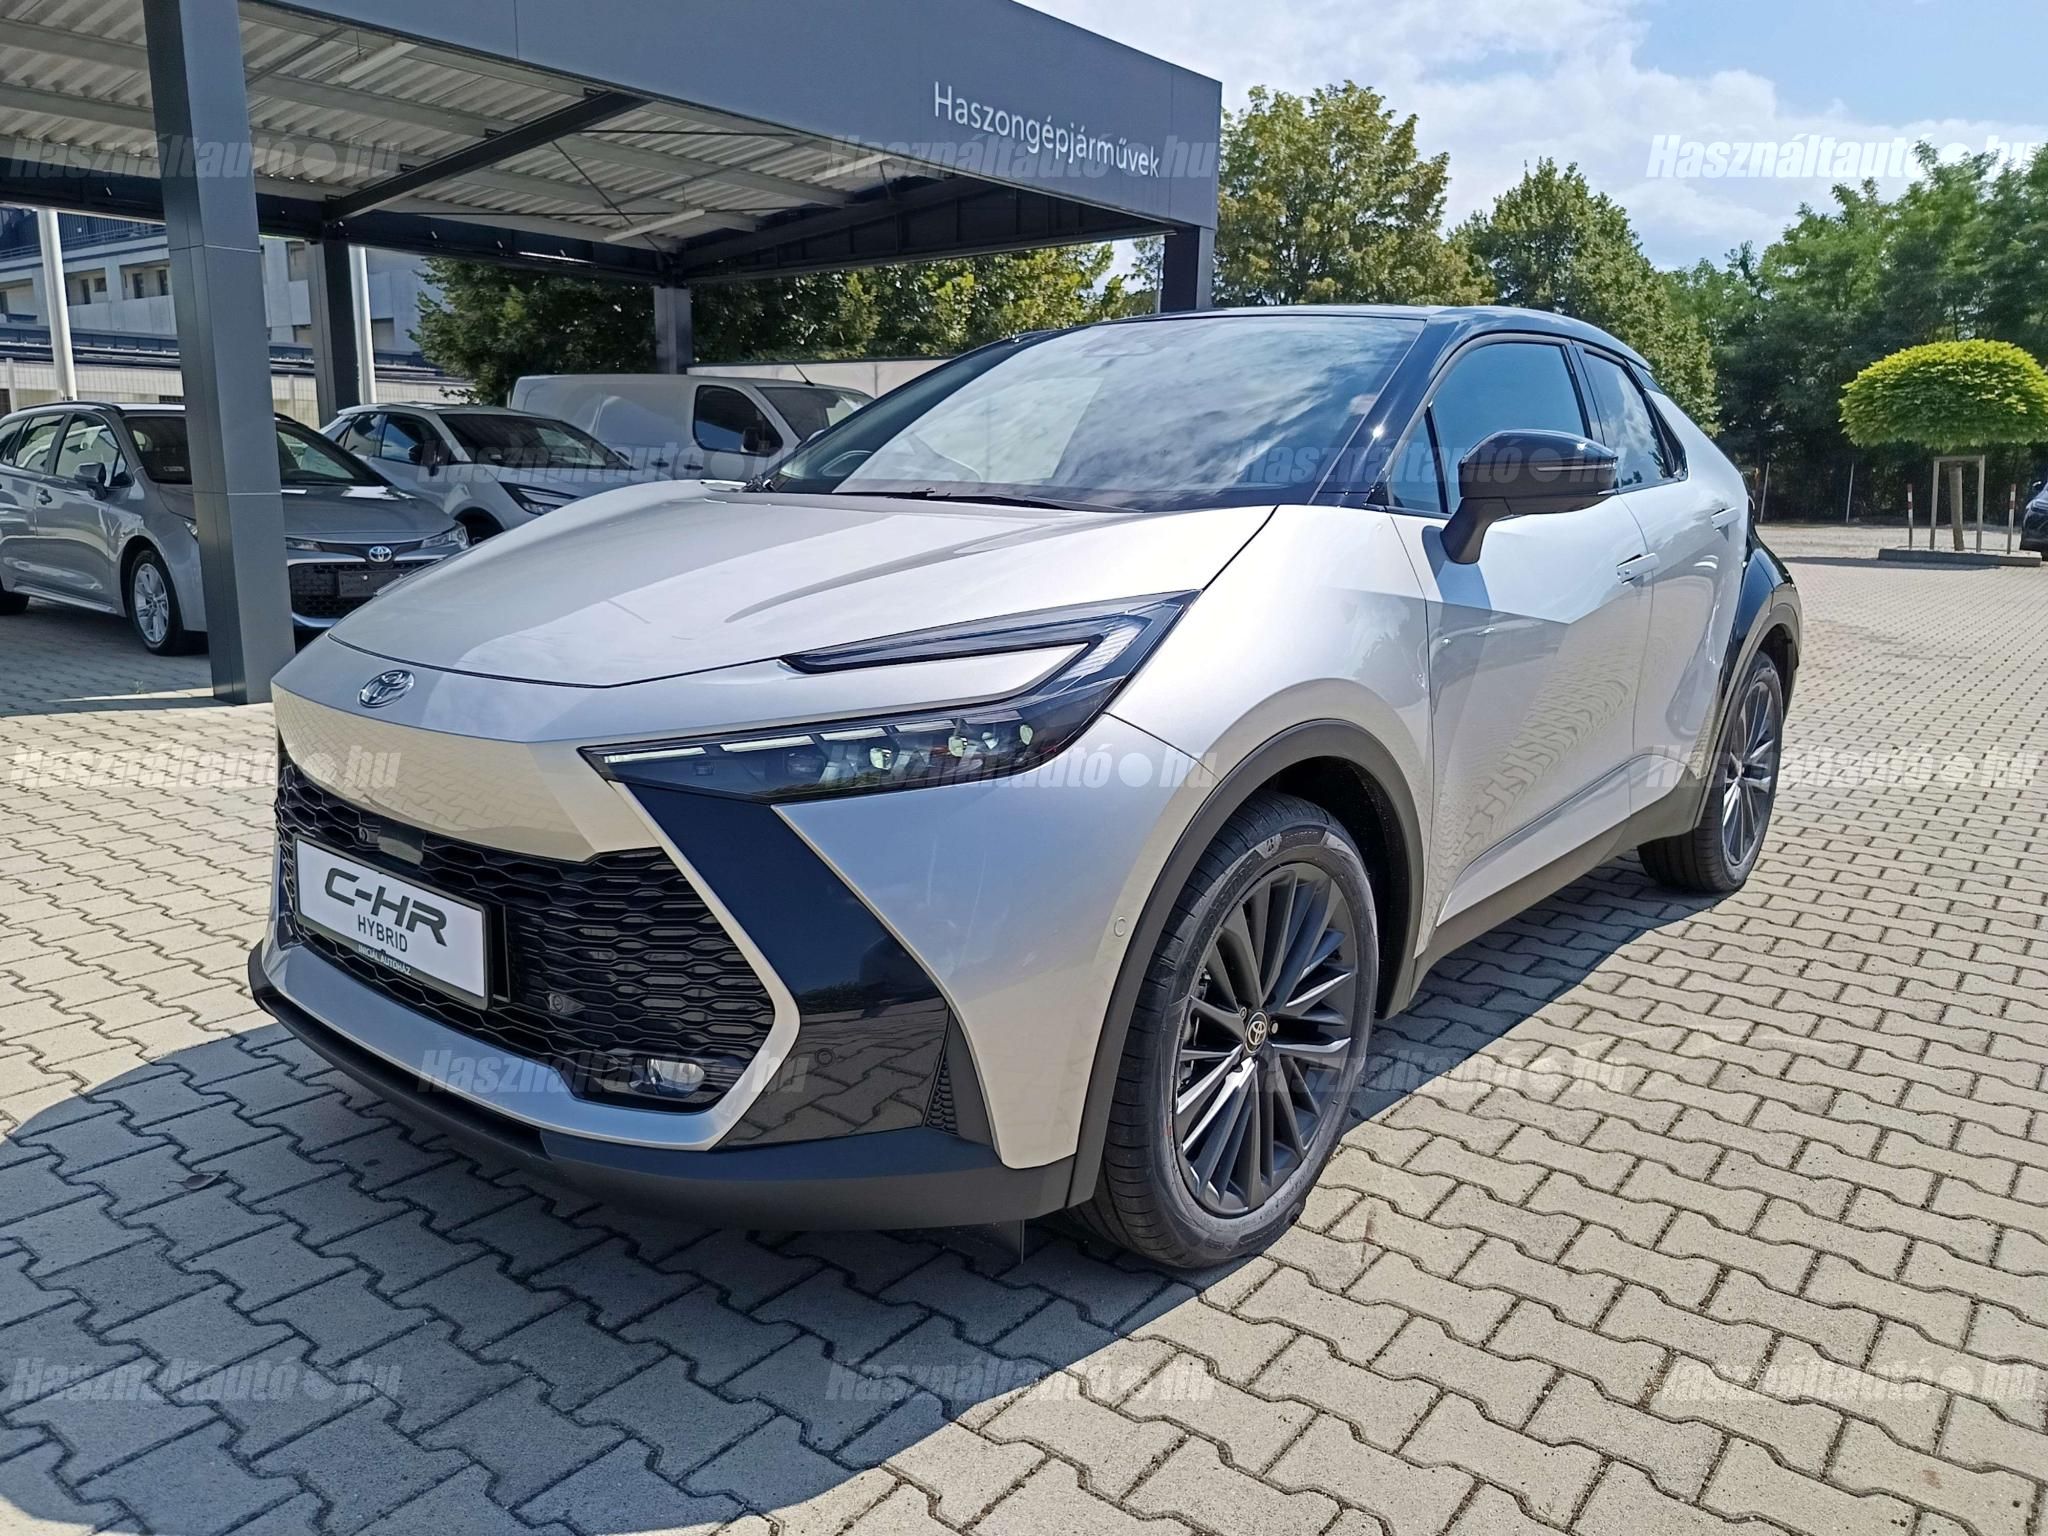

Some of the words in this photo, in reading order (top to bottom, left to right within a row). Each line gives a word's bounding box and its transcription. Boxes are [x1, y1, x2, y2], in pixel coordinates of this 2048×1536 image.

[933, 81, 1160, 178] Haszongépjárművek
[325, 867, 448, 947] C-HR
[357, 914, 408, 952] HYBRID
